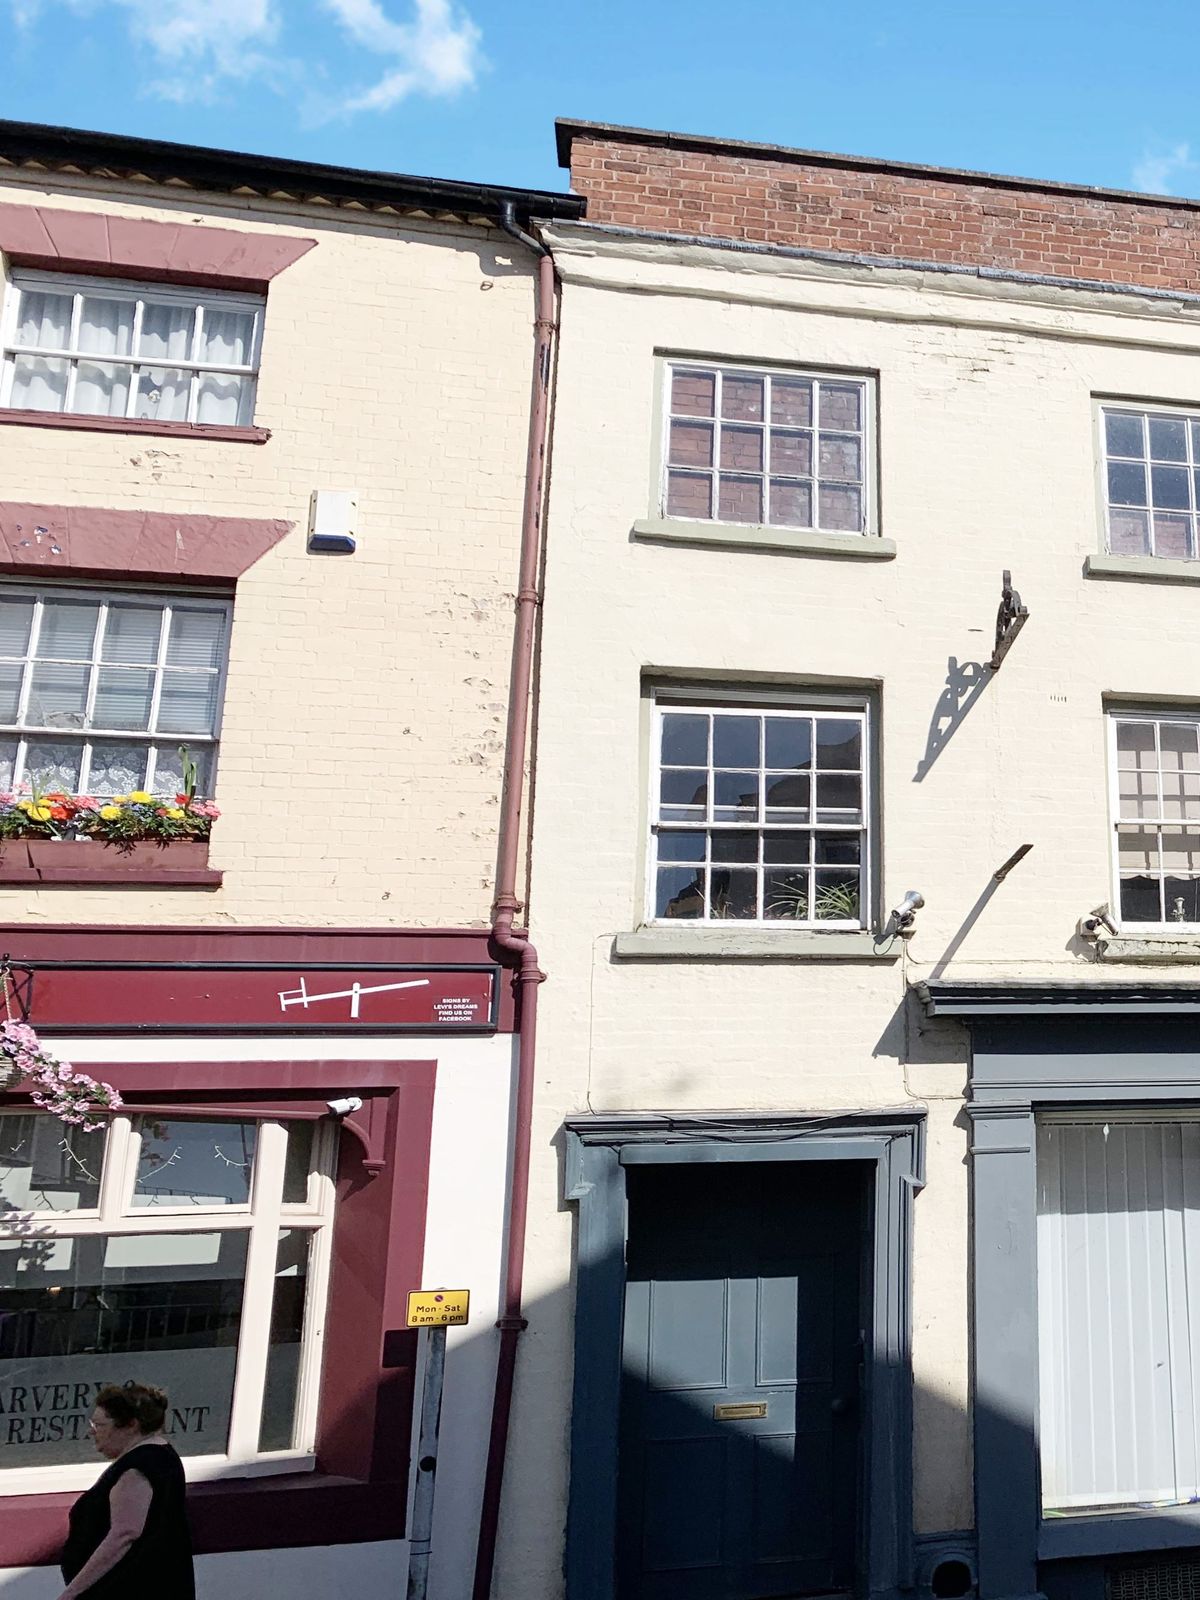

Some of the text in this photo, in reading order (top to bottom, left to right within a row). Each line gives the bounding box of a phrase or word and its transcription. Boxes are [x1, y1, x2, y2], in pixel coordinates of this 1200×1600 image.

[416, 1305, 437, 1313] Mon
[444, 1304, 461, 1312] Sat
[411, 1315, 418, 1323] 8
[5, 1406, 210, 1445] RESTNT
